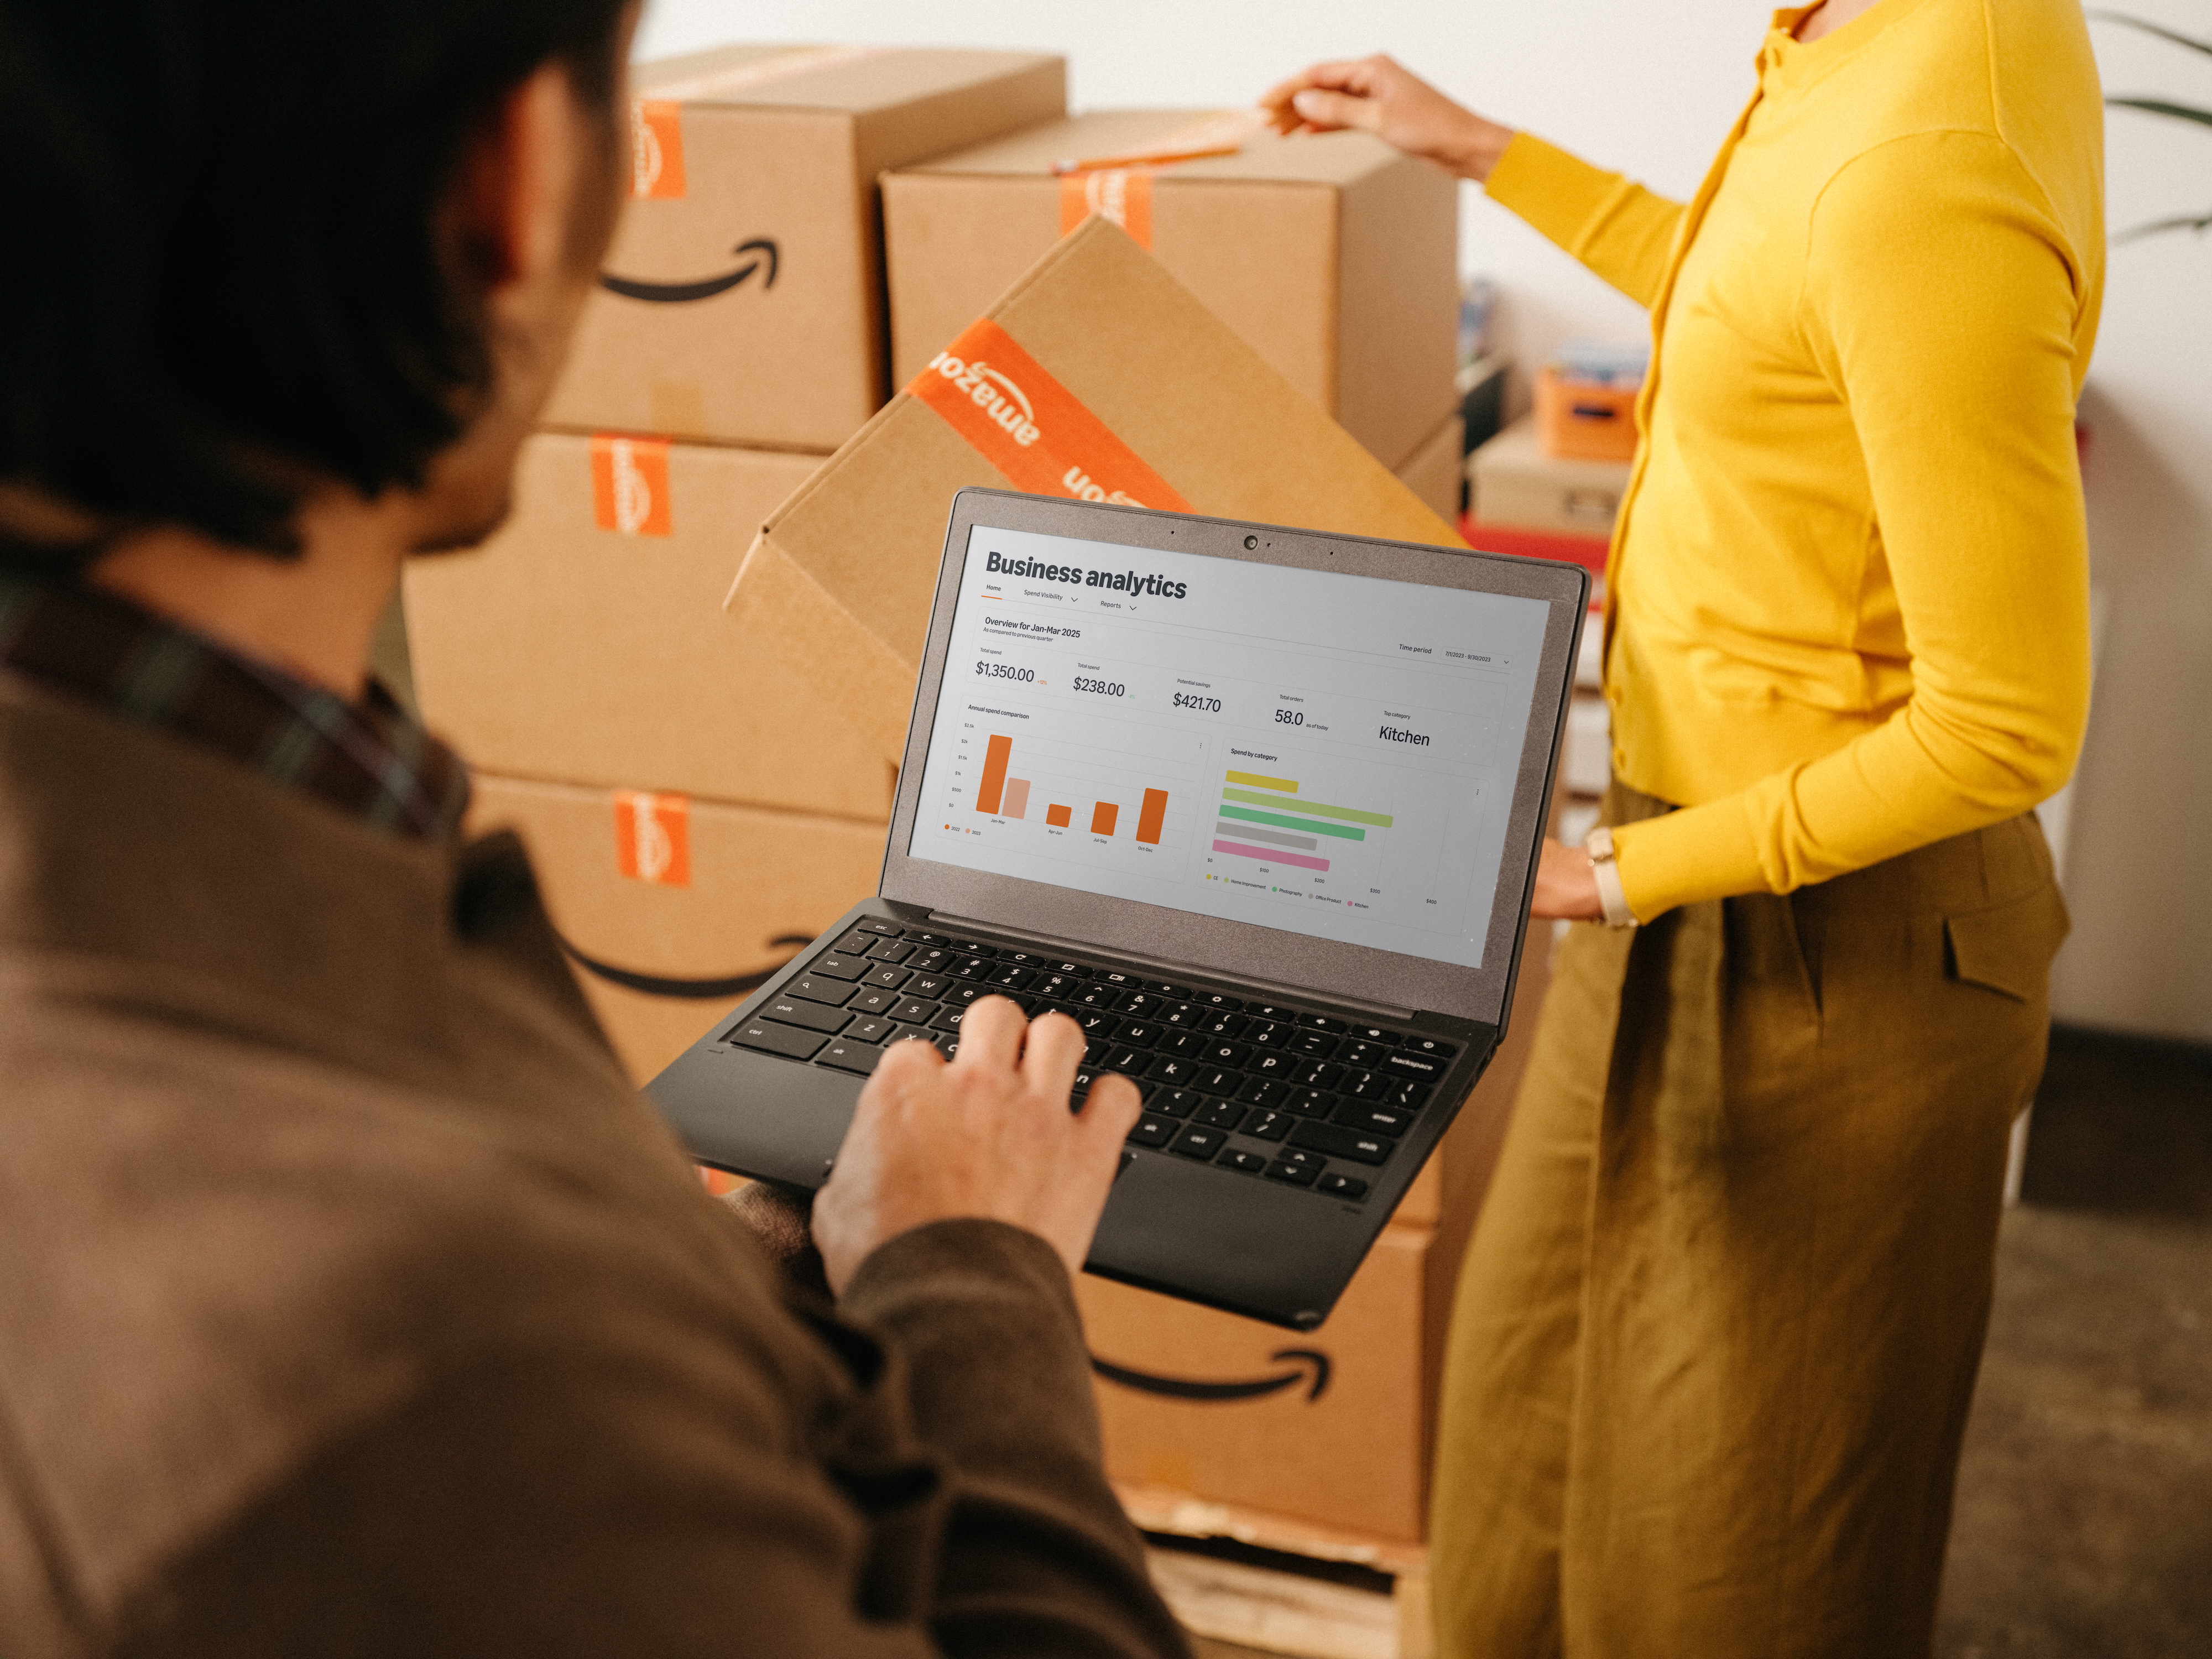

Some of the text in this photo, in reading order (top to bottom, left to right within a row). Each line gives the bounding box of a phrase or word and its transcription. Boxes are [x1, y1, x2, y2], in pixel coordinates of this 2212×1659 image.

[986, 551, 1187, 599] Business analytics
[1041, 592, 1063, 601] Visibility
[1100, 601, 1121, 609] Reports
[985, 617, 1019, 628] Overview
[1031, 624, 1061, 635] Jan-Mar
[1061, 628, 1081, 638] 2025
[975, 660, 1034, 682] $1,350.00
[1073, 676, 1125, 697] $238.00
[1173, 692, 1221, 712] $421.70
[1000, 711, 1029, 719] comparison
[1275, 709, 1303, 726] 58.0
[1379, 726, 1430, 746] Kitchen
[1254, 753, 1277, 761] category
[1279, 888, 1302, 897] Photography
[1086, 1018, 1100, 1027] y
[1178, 1037, 1186, 1045] i
[1120, 1054, 1133, 1065] j
[1262, 1058, 1276, 1067] p
[1391, 1057, 1433, 1070] backspace
[1166, 1063, 1177, 1073] k
